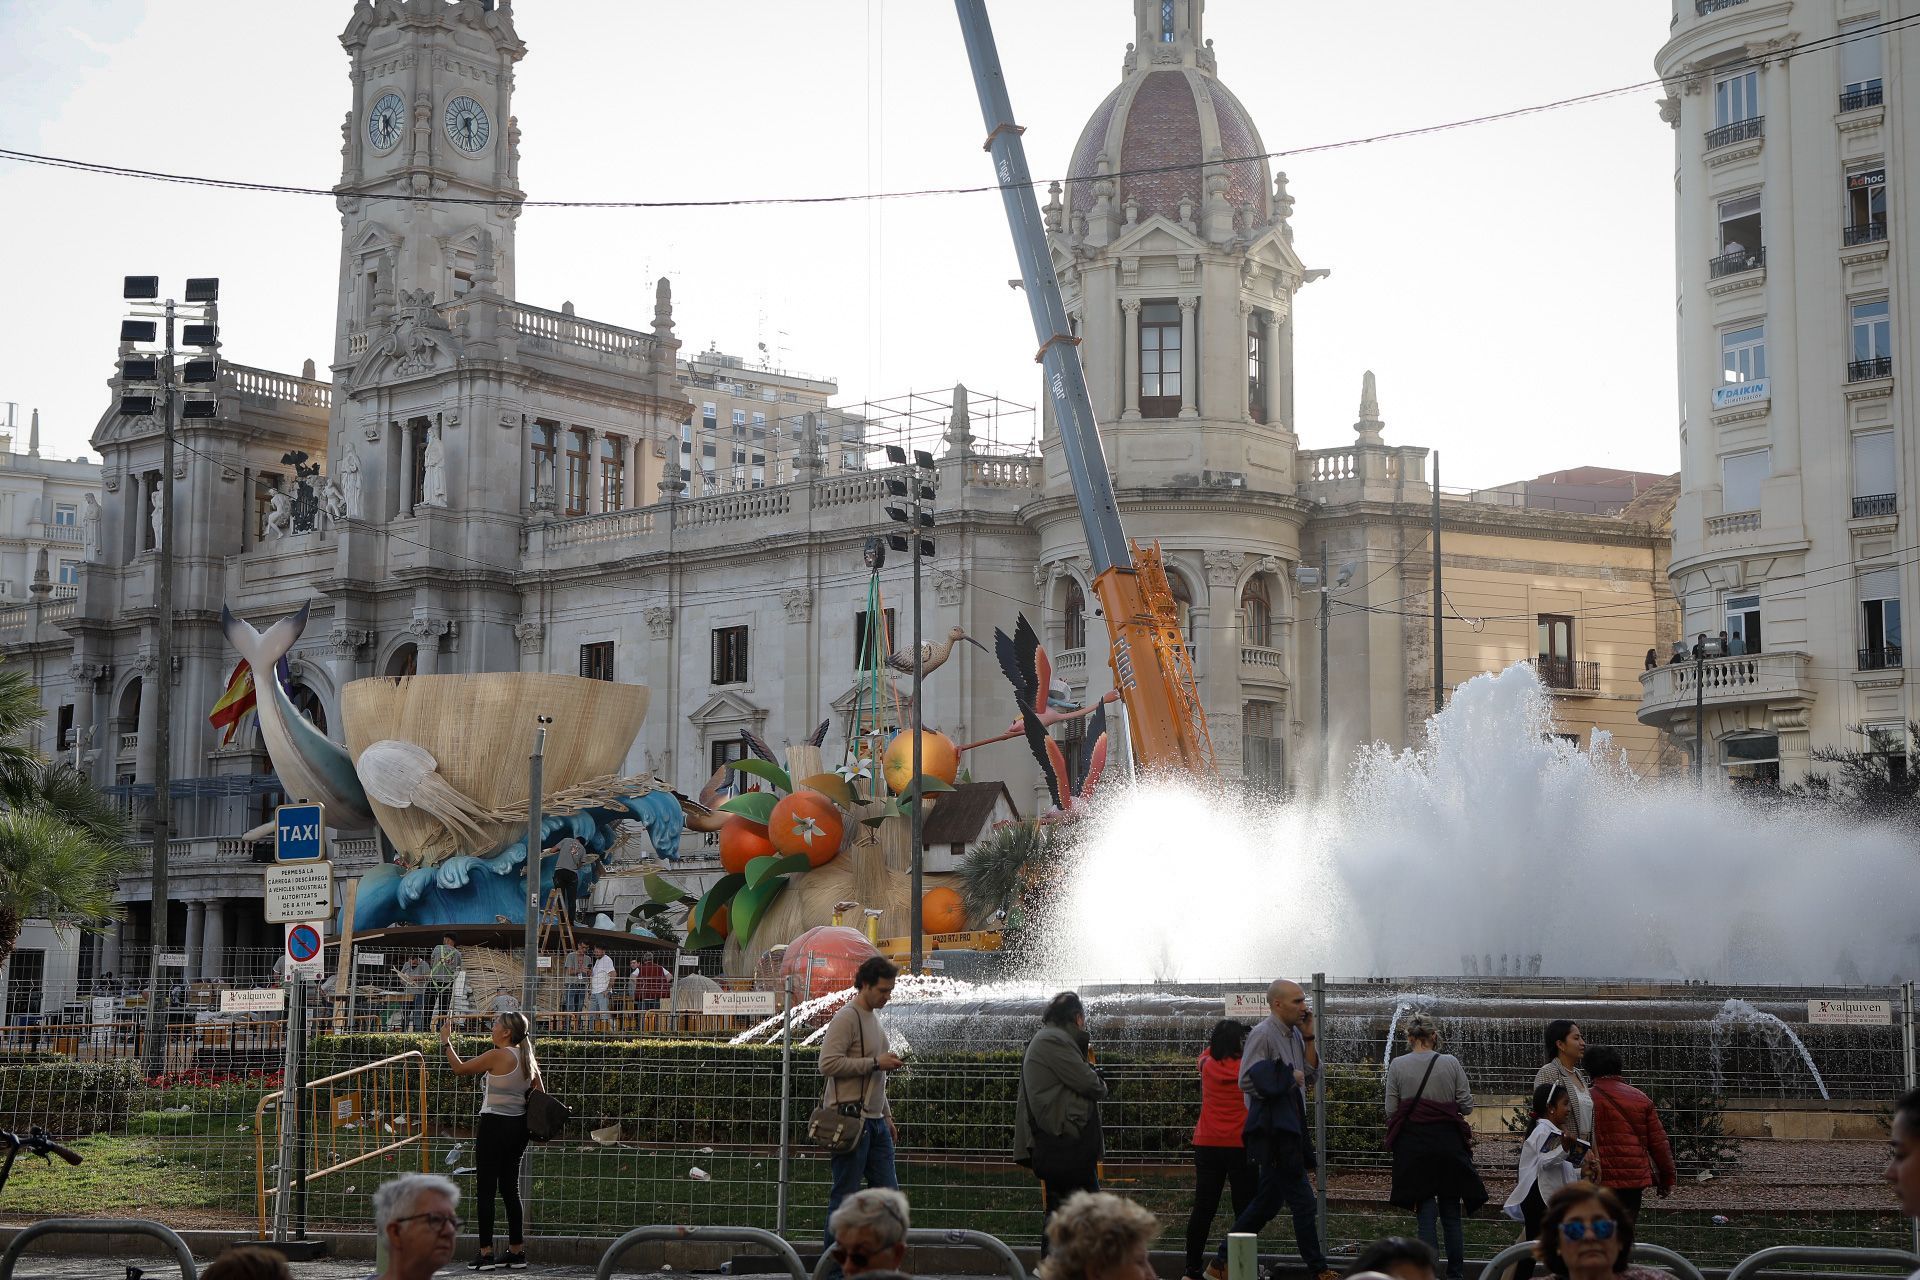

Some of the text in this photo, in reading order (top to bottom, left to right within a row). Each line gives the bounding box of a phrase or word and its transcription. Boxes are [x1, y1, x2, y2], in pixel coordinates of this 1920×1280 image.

[1850, 174, 1884, 188] Adhoc
[1052, 372, 1066, 400] rigar
[1725, 384, 1764, 398] DAIKIN
[279, 824, 319, 842] TAXI
[281, 868, 306, 876] PERMESA
[295, 883, 327, 891] INDUSTRIALS
[281, 892, 318, 900] AUTORITZATS
[959, 933, 971, 942] PRO
[237, 991, 277, 1002] valquiven
[722, 994, 766, 1005] valquiven
[1830, 1002, 1881, 1014] valquiven
